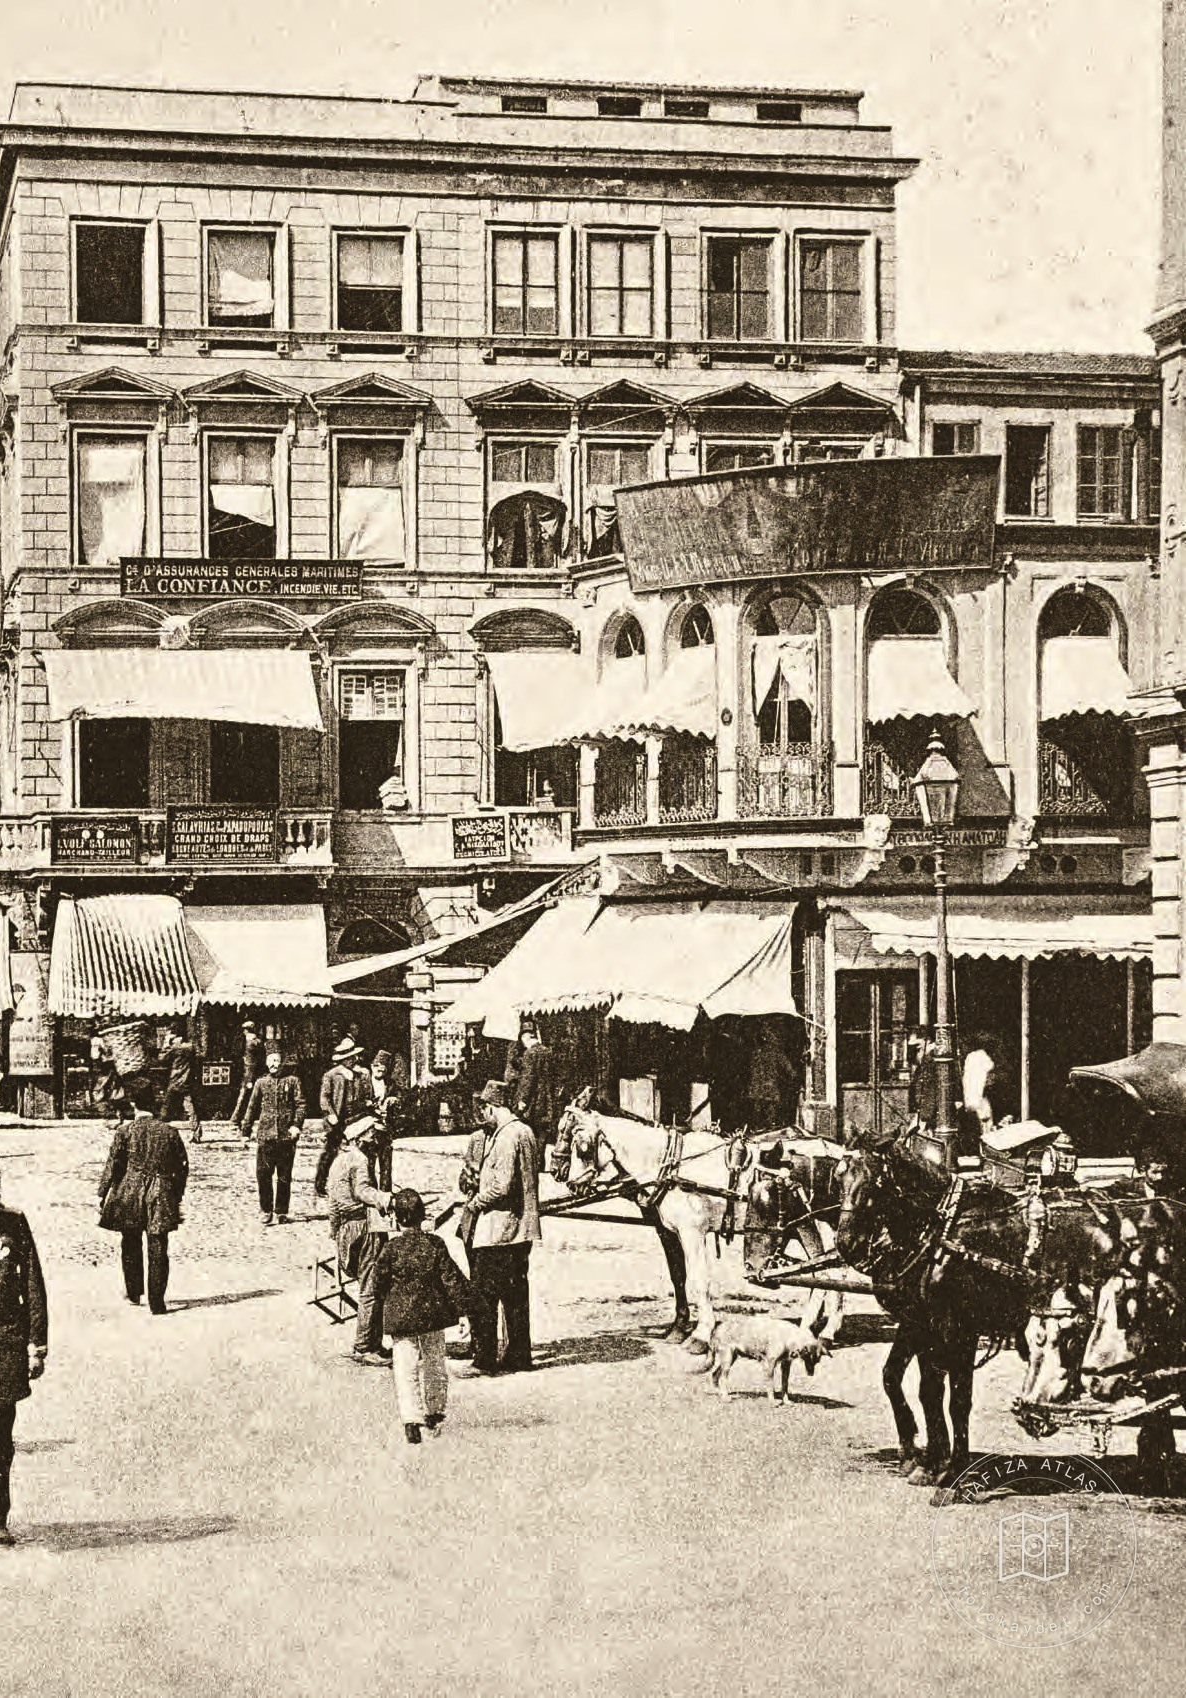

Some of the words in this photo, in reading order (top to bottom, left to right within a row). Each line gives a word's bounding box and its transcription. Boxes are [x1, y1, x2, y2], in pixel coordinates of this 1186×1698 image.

[302, 566, 359, 578] MARITIMES
[124, 579, 150, 594] LA
[204, 834, 228, 843] CHOIX
[231, 834, 242, 843] DE
[244, 834, 270, 843] DRAPS
